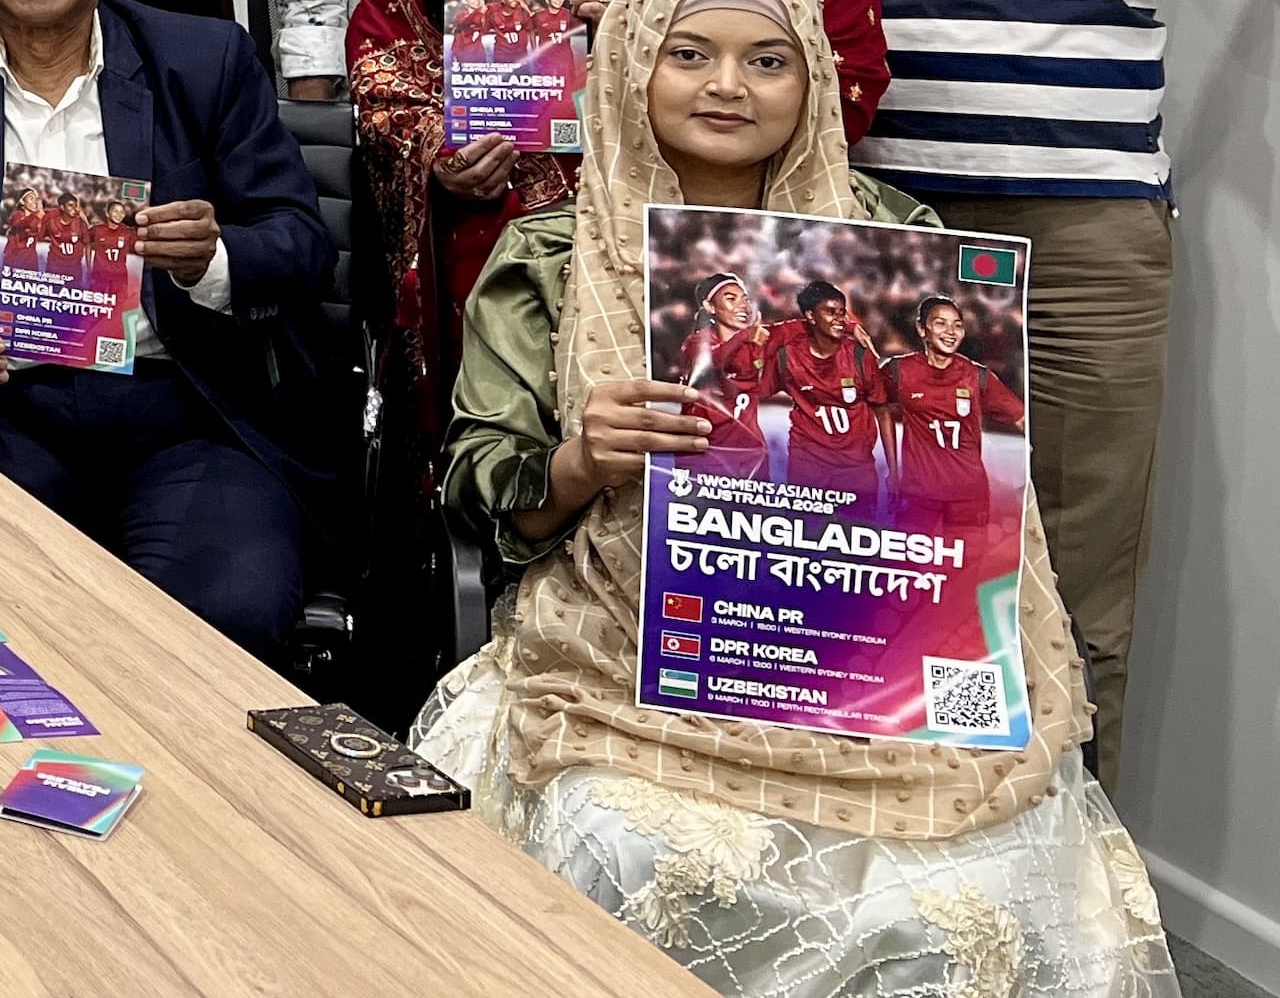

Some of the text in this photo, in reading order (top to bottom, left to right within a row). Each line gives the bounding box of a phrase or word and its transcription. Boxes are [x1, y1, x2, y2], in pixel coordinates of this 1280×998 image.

[451, 74, 564, 87] BANGLADESH
[0, 278, 116, 306] BANGLADESH
[814, 404, 850, 435] 10
[928, 419, 961, 450] 17
[697, 486, 791, 509] AUSTRALIA
[702, 475, 857, 505] WOMEN'S ASIAN CUP
[668, 502, 965, 568] BANGLADESH
[666, 539, 947, 603] চলো বাংলাদেশ
[714, 600, 803, 624] CHINA PR
[718, 618, 747, 627] MARCH
[710, 638, 818, 664] DPR KOREA
[717, 657, 745, 666] MARCH
[707, 675, 828, 704] UZBEKISTAN
[715, 695, 743, 705] MARCH
